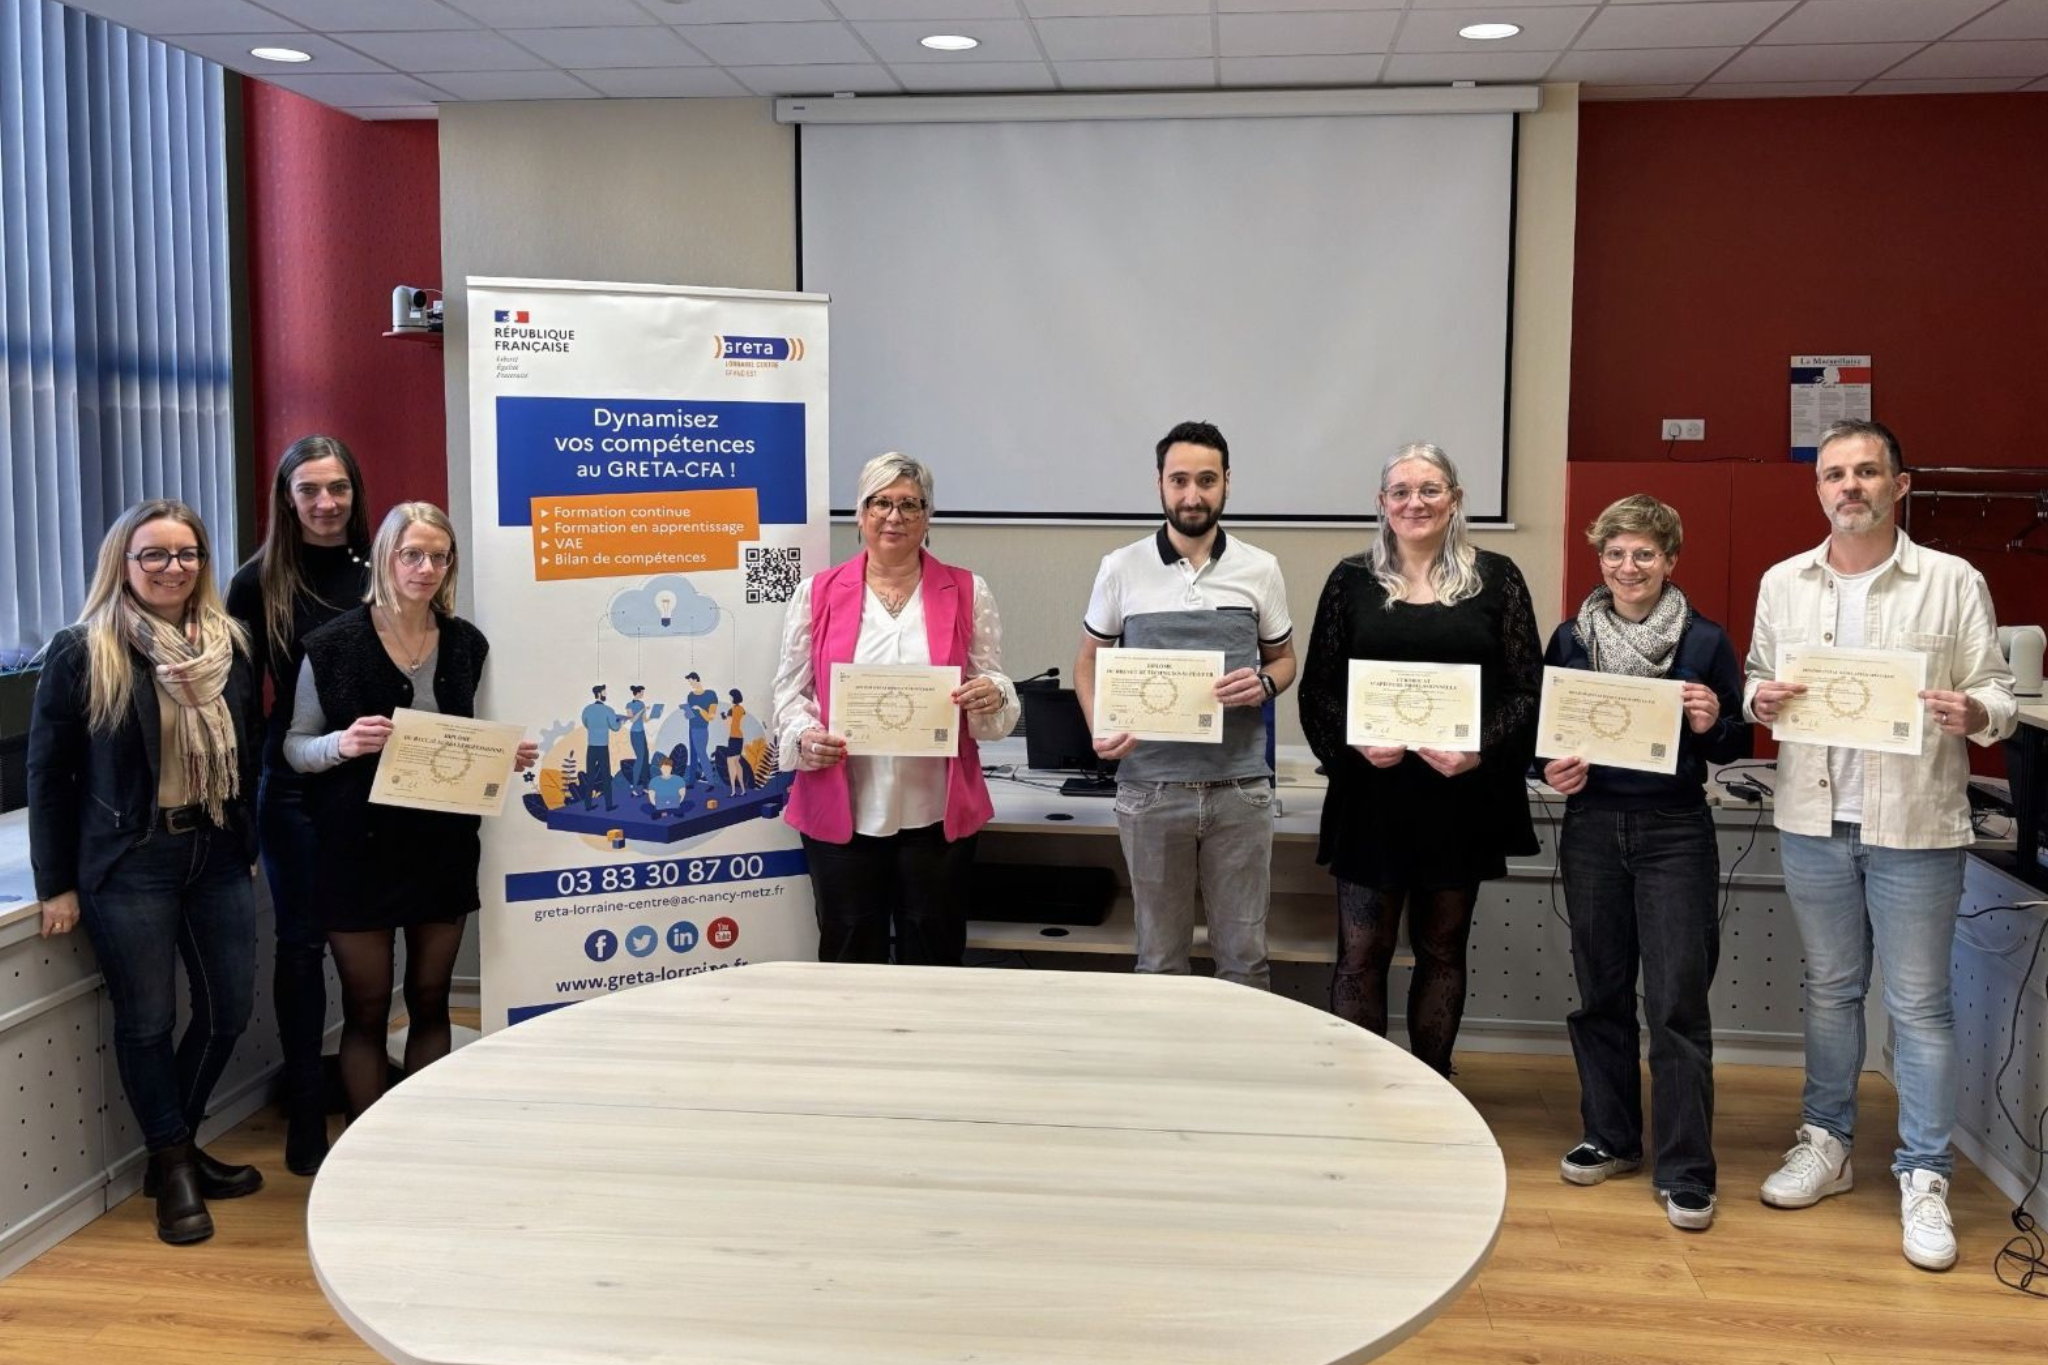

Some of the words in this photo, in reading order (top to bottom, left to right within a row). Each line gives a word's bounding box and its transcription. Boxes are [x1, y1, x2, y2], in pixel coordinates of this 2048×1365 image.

[495, 325, 575, 341] RÉPUBLIQUE
[495, 340, 570, 353] FRANÇAISE
[594, 408, 719, 432] Dynamisez
[554, 437, 594, 452] vos
[601, 434, 755, 458] compétences
[576, 464, 601, 477] au
[607, 461, 724, 478] GRETA-CFA
[730, 462, 736, 477] !
[554, 506, 626, 518] Formation
[630, 506, 690, 517] continue
[554, 522, 626, 534] Formation
[630, 524, 648, 533] en
[652, 521, 745, 537] apprentissage
[555, 538, 583, 549] VAE
[555, 552, 589, 565] Bilan
[593, 552, 611, 564] de
[614, 551, 707, 566] compétences
[557, 870, 592, 895] 03
[601, 866, 636, 891] 83
[645, 862, 680, 887] 30
[688, 859, 721, 882] 87
[730, 855, 763, 879] 00
[534, 885, 785, 922] greta-lorraine-centre@ac-nancy-metz.fr
